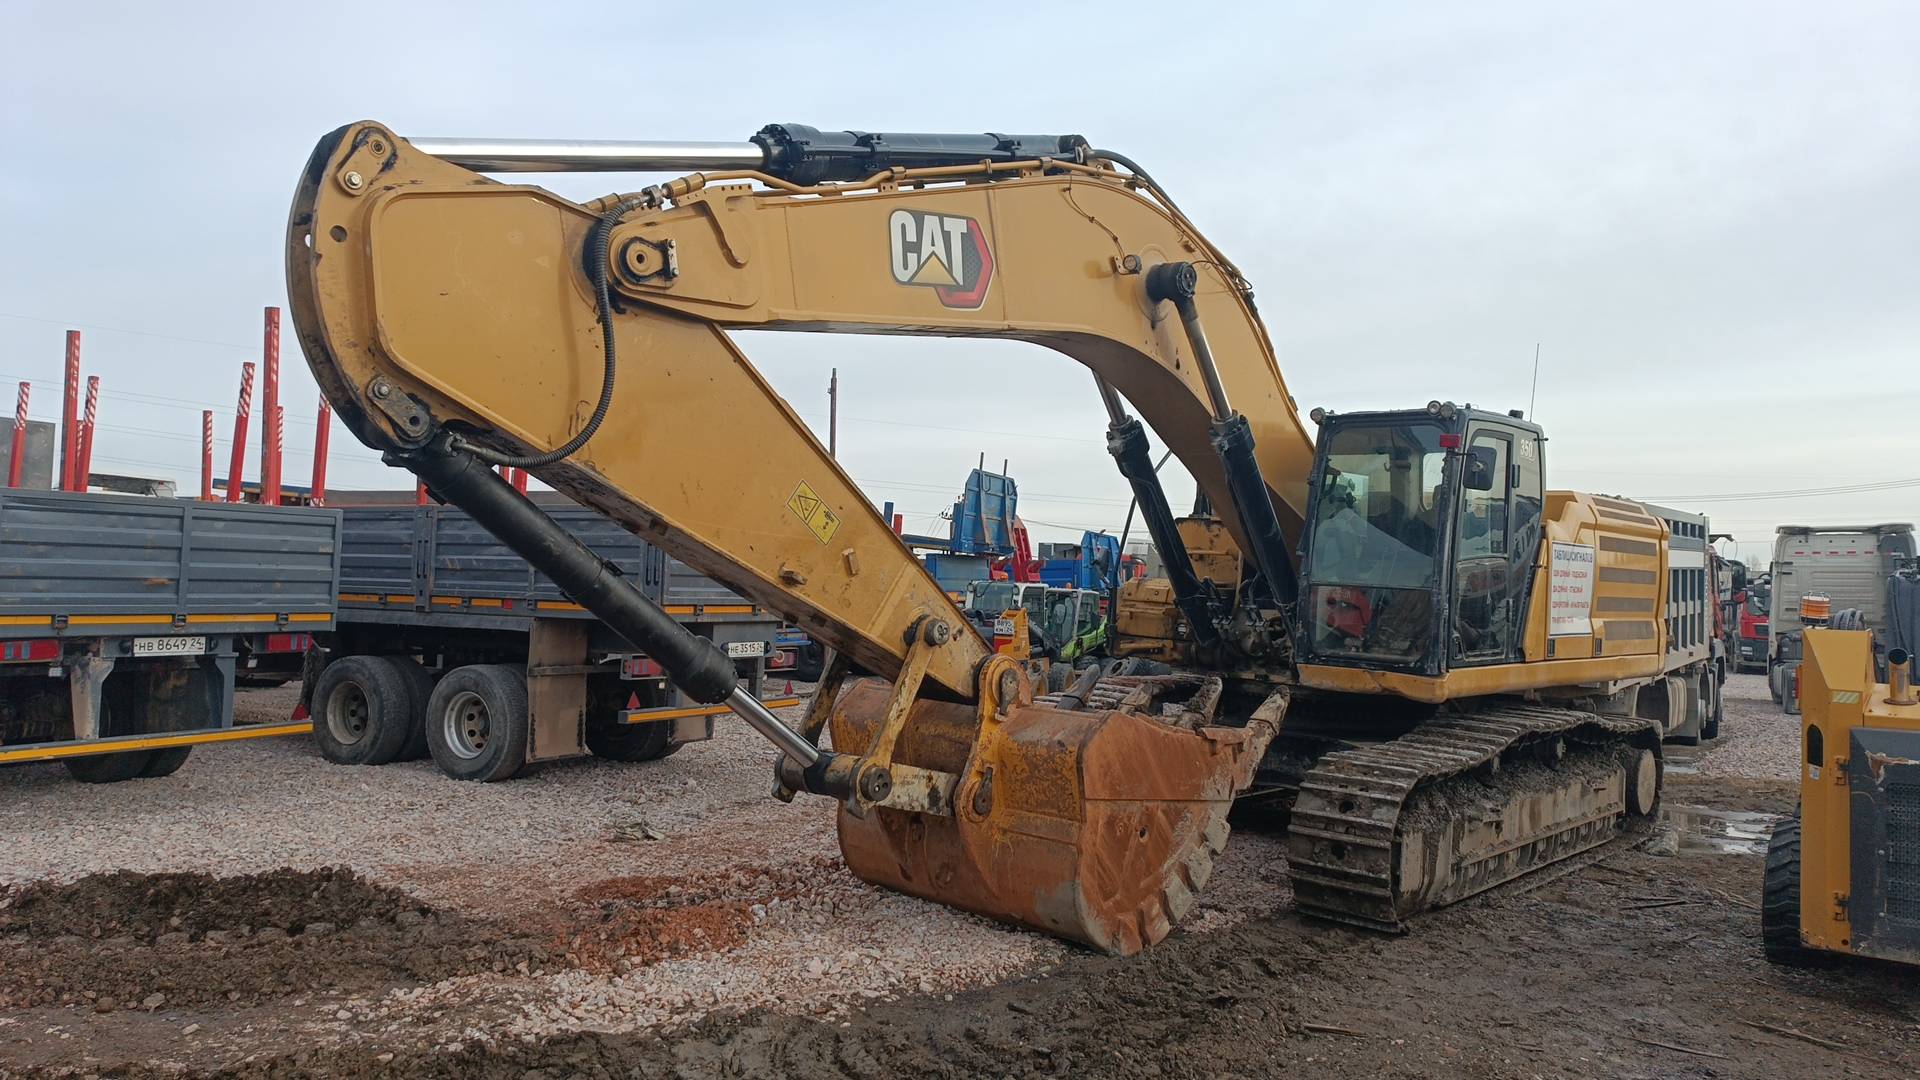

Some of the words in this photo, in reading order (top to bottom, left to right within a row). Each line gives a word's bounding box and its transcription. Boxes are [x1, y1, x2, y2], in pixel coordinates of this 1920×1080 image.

[890, 210, 968, 286] CAT
[1520, 439, 1533, 457] 350
[139, 641, 154, 651] НВ
[157, 638, 187, 649] 8649
[190, 638, 203, 647] 24
[730, 646, 739, 654] НЕ
[740, 643, 756, 653] 3515
